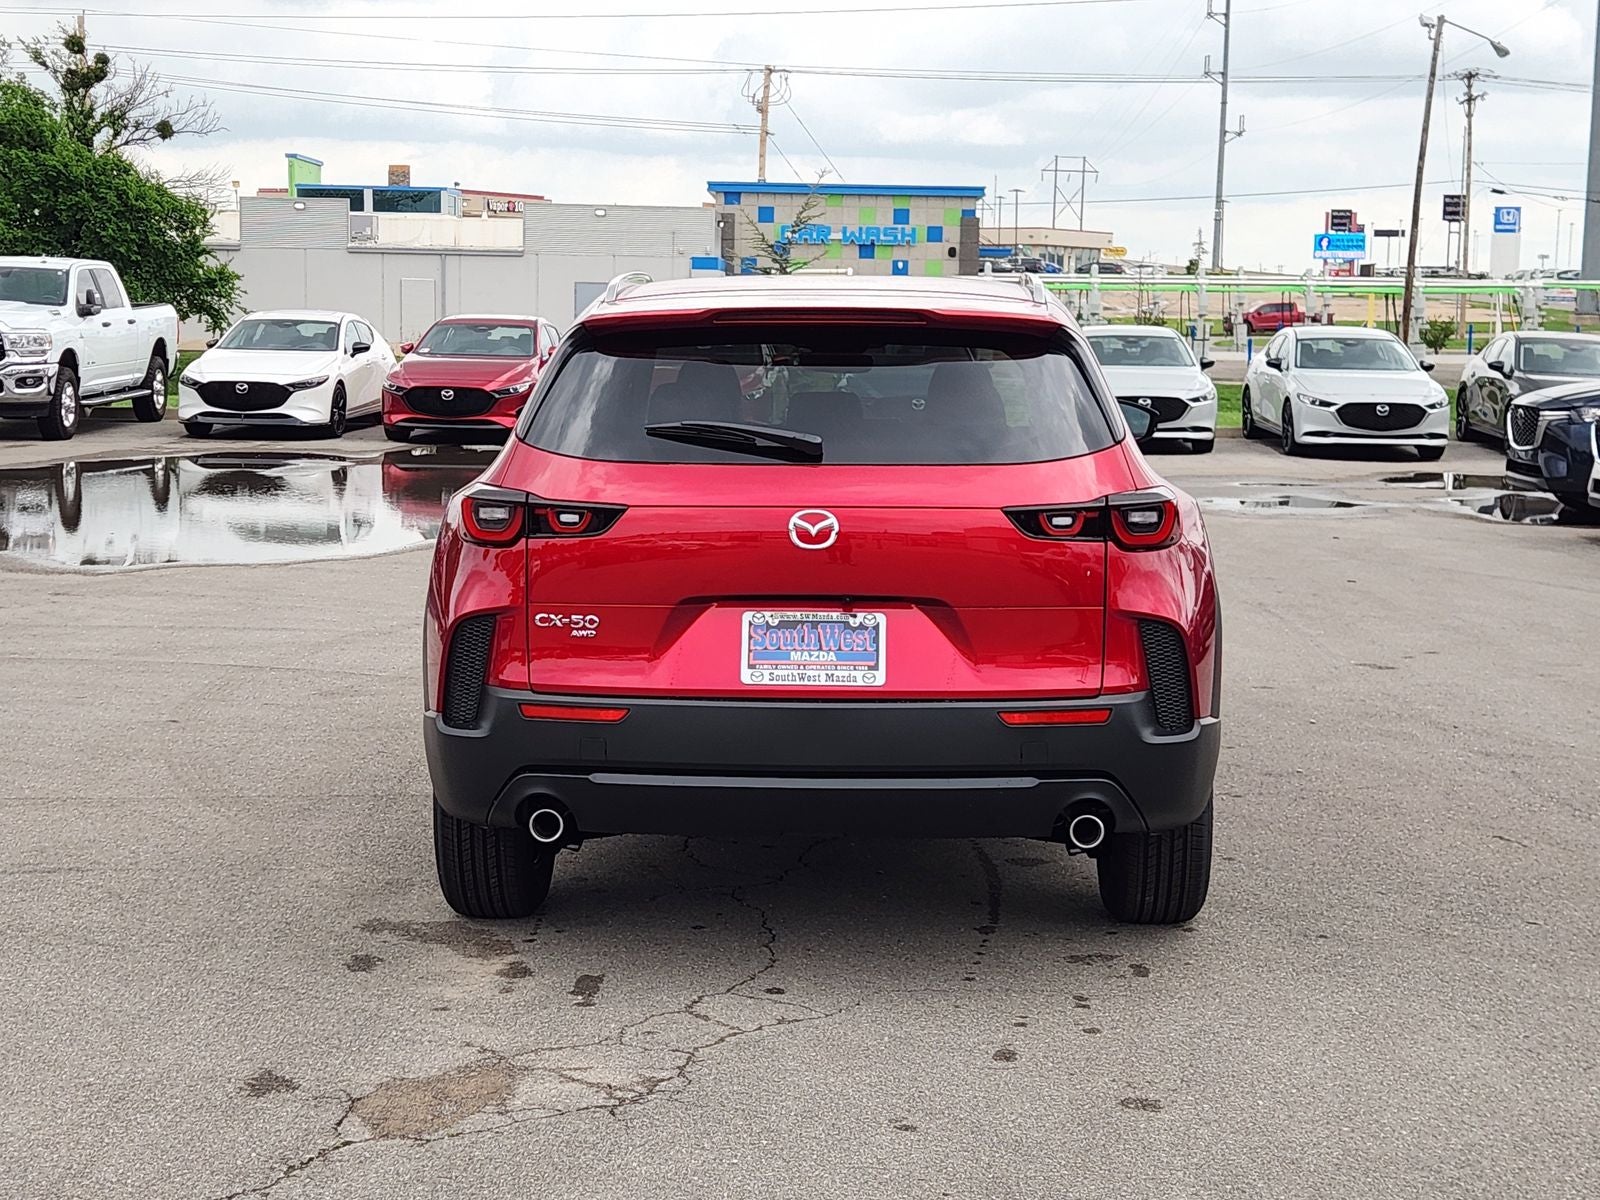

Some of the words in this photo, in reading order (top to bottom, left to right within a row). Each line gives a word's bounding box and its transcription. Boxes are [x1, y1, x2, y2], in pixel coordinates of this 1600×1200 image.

[488, 199, 508, 214] Vapor
[780, 224, 832, 245] CAR
[841, 225, 918, 246] WASH
[534, 613, 600, 629] CX-50
[779, 612, 850, 621] www.SWMazda.com
[570, 629, 597, 638] AWD
[750, 622, 877, 651] SouthWest
[790, 651, 837, 662] MAZDA
[768, 672, 822, 683] SouthWest
[824, 673, 858, 683] Mazda
